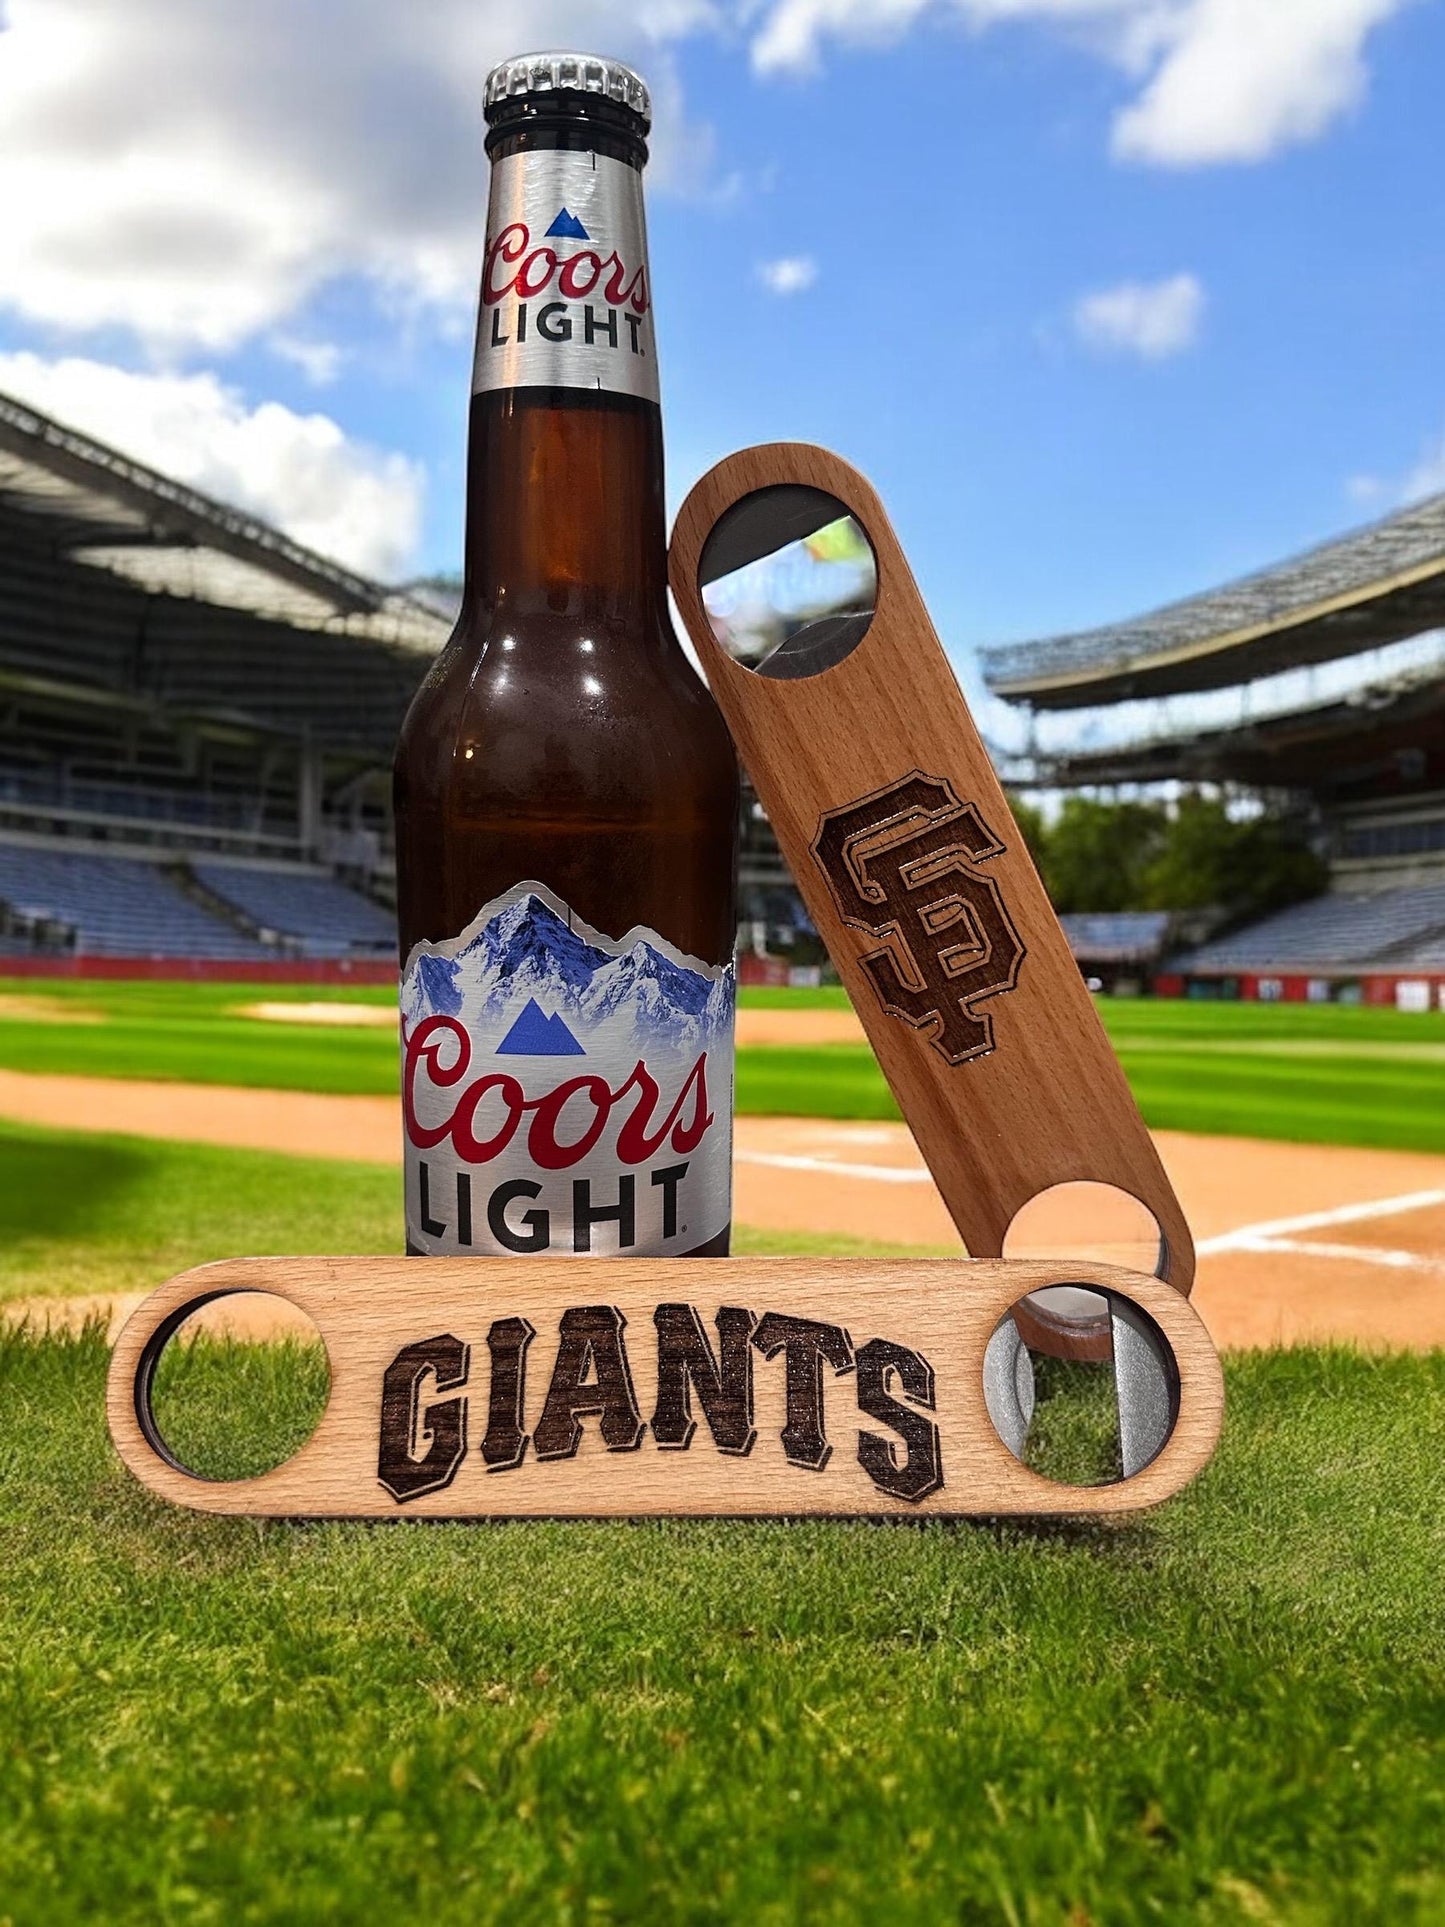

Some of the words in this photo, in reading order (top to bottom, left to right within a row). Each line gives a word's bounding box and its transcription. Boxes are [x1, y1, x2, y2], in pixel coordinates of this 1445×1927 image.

[483, 223, 650, 314] Coors
[809, 768, 1028, 1067] SF
[402, 1014, 714, 1170] Coors
[377, 1303, 945, 1504] GIANTS
